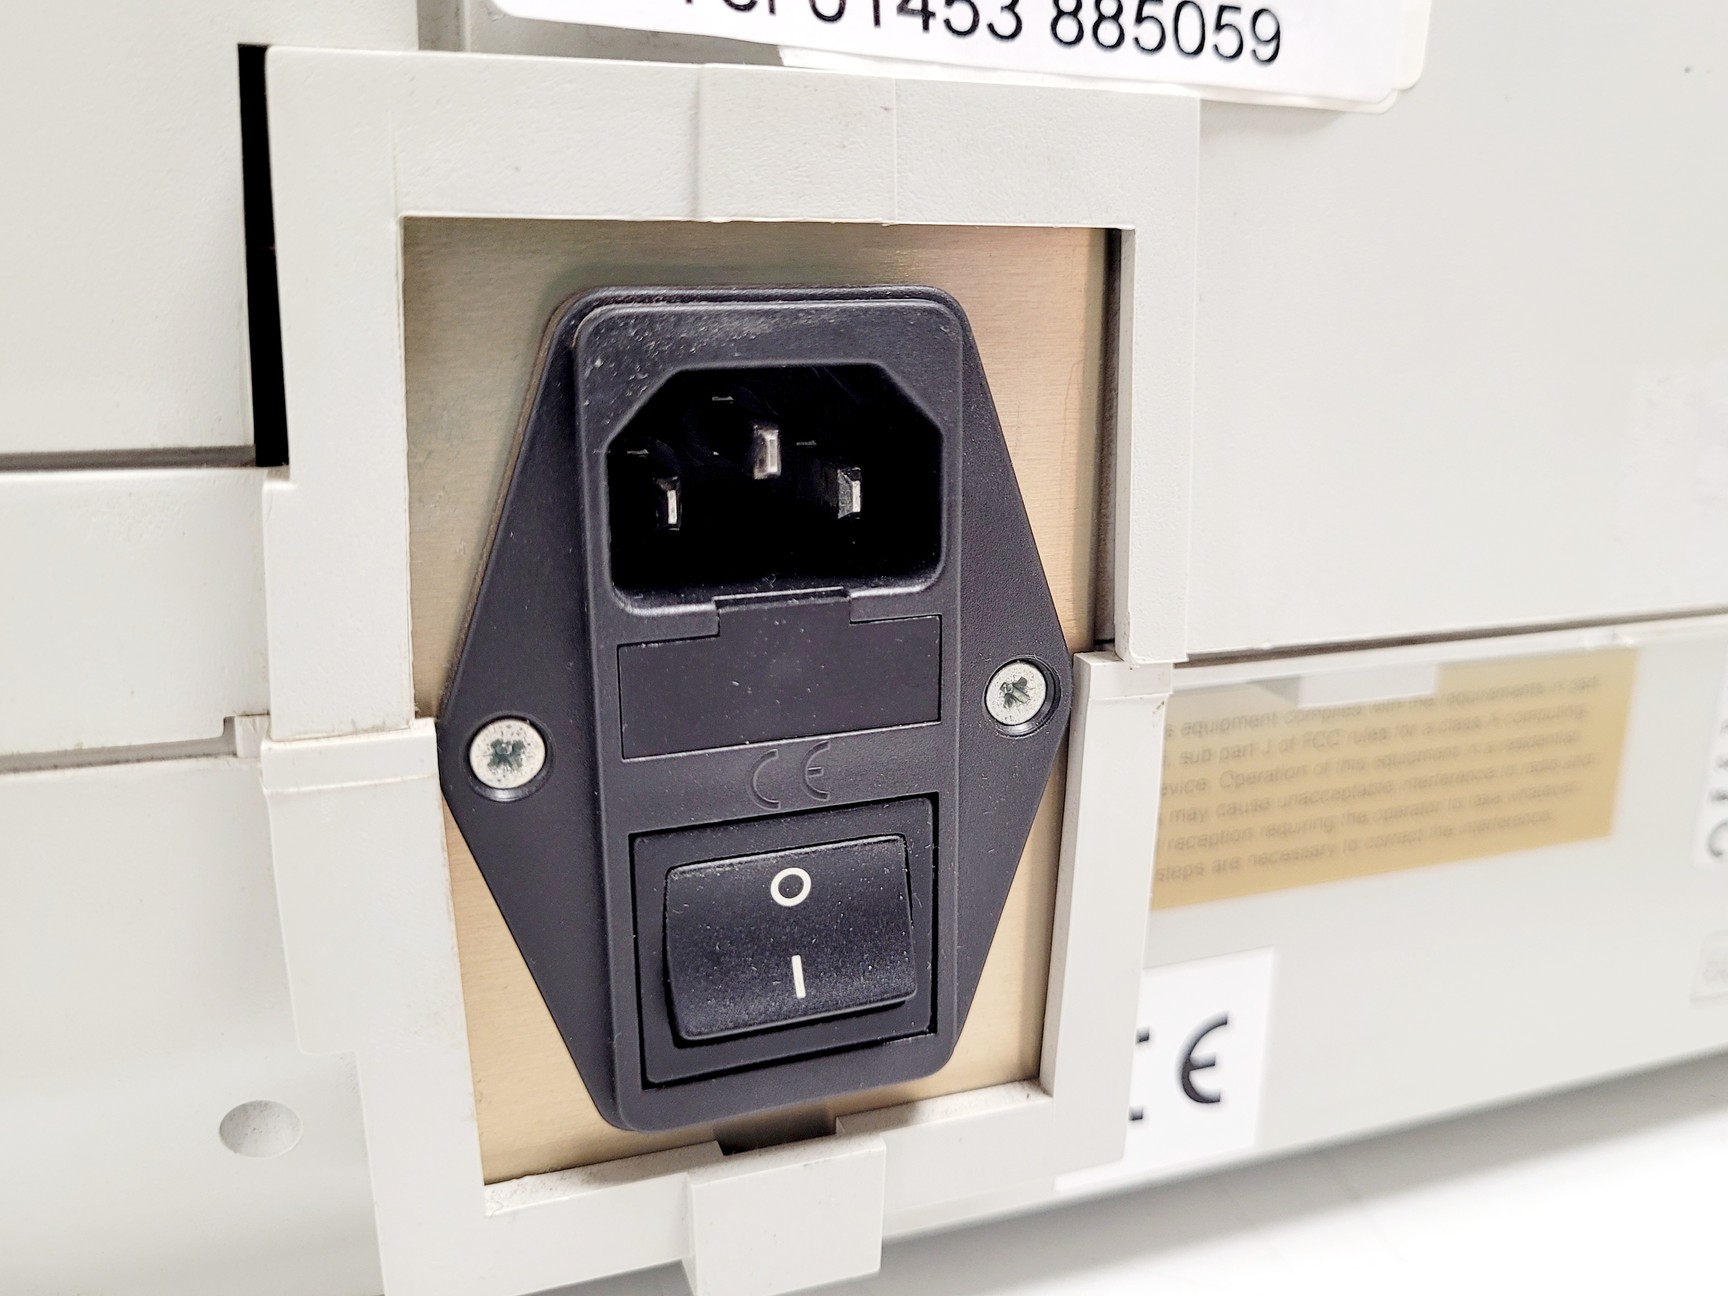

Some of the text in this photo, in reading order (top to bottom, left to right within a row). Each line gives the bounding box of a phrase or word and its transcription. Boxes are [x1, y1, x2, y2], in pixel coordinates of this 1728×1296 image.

[1050, 0, 1281, 64] 885059
[1181, 711, 1278, 740] equipment
[1285, 703, 1363, 727] complies
[1441, 681, 1546, 706] requirements
[1180, 747, 1212, 766] sub
[1219, 742, 1254, 764] part
[1278, 736, 1297, 754] of
[1301, 728, 1343, 750] FCC
[1348, 724, 1389, 744] rules
[1394, 721, 1416, 738] for
[1440, 715, 1482, 735] class
[1219, 762, 1308, 792] Operation
[1313, 759, 1331, 777] of
[1337, 755, 1367, 773] this
[1372, 743, 1459, 772] equipment
[751, 740, 831, 811] CE
[1169, 805, 1208, 825] may
[1216, 796, 1271, 817] cause
[1278, 777, 1394, 811] unacceptable
[1400, 765, 1496, 791] interference
[1167, 826, 1253, 853] reception
[1261, 810, 1336, 839] requiring
[1340, 808, 1367, 827] the
[1373, 799, 1441, 824] operator
[1156, 861, 1206, 884] steps
[1212, 855, 1242, 874] are
[1248, 841, 1336, 868] necessary
[1343, 837, 1360, 854] to
[1365, 828, 1423, 849] correct
